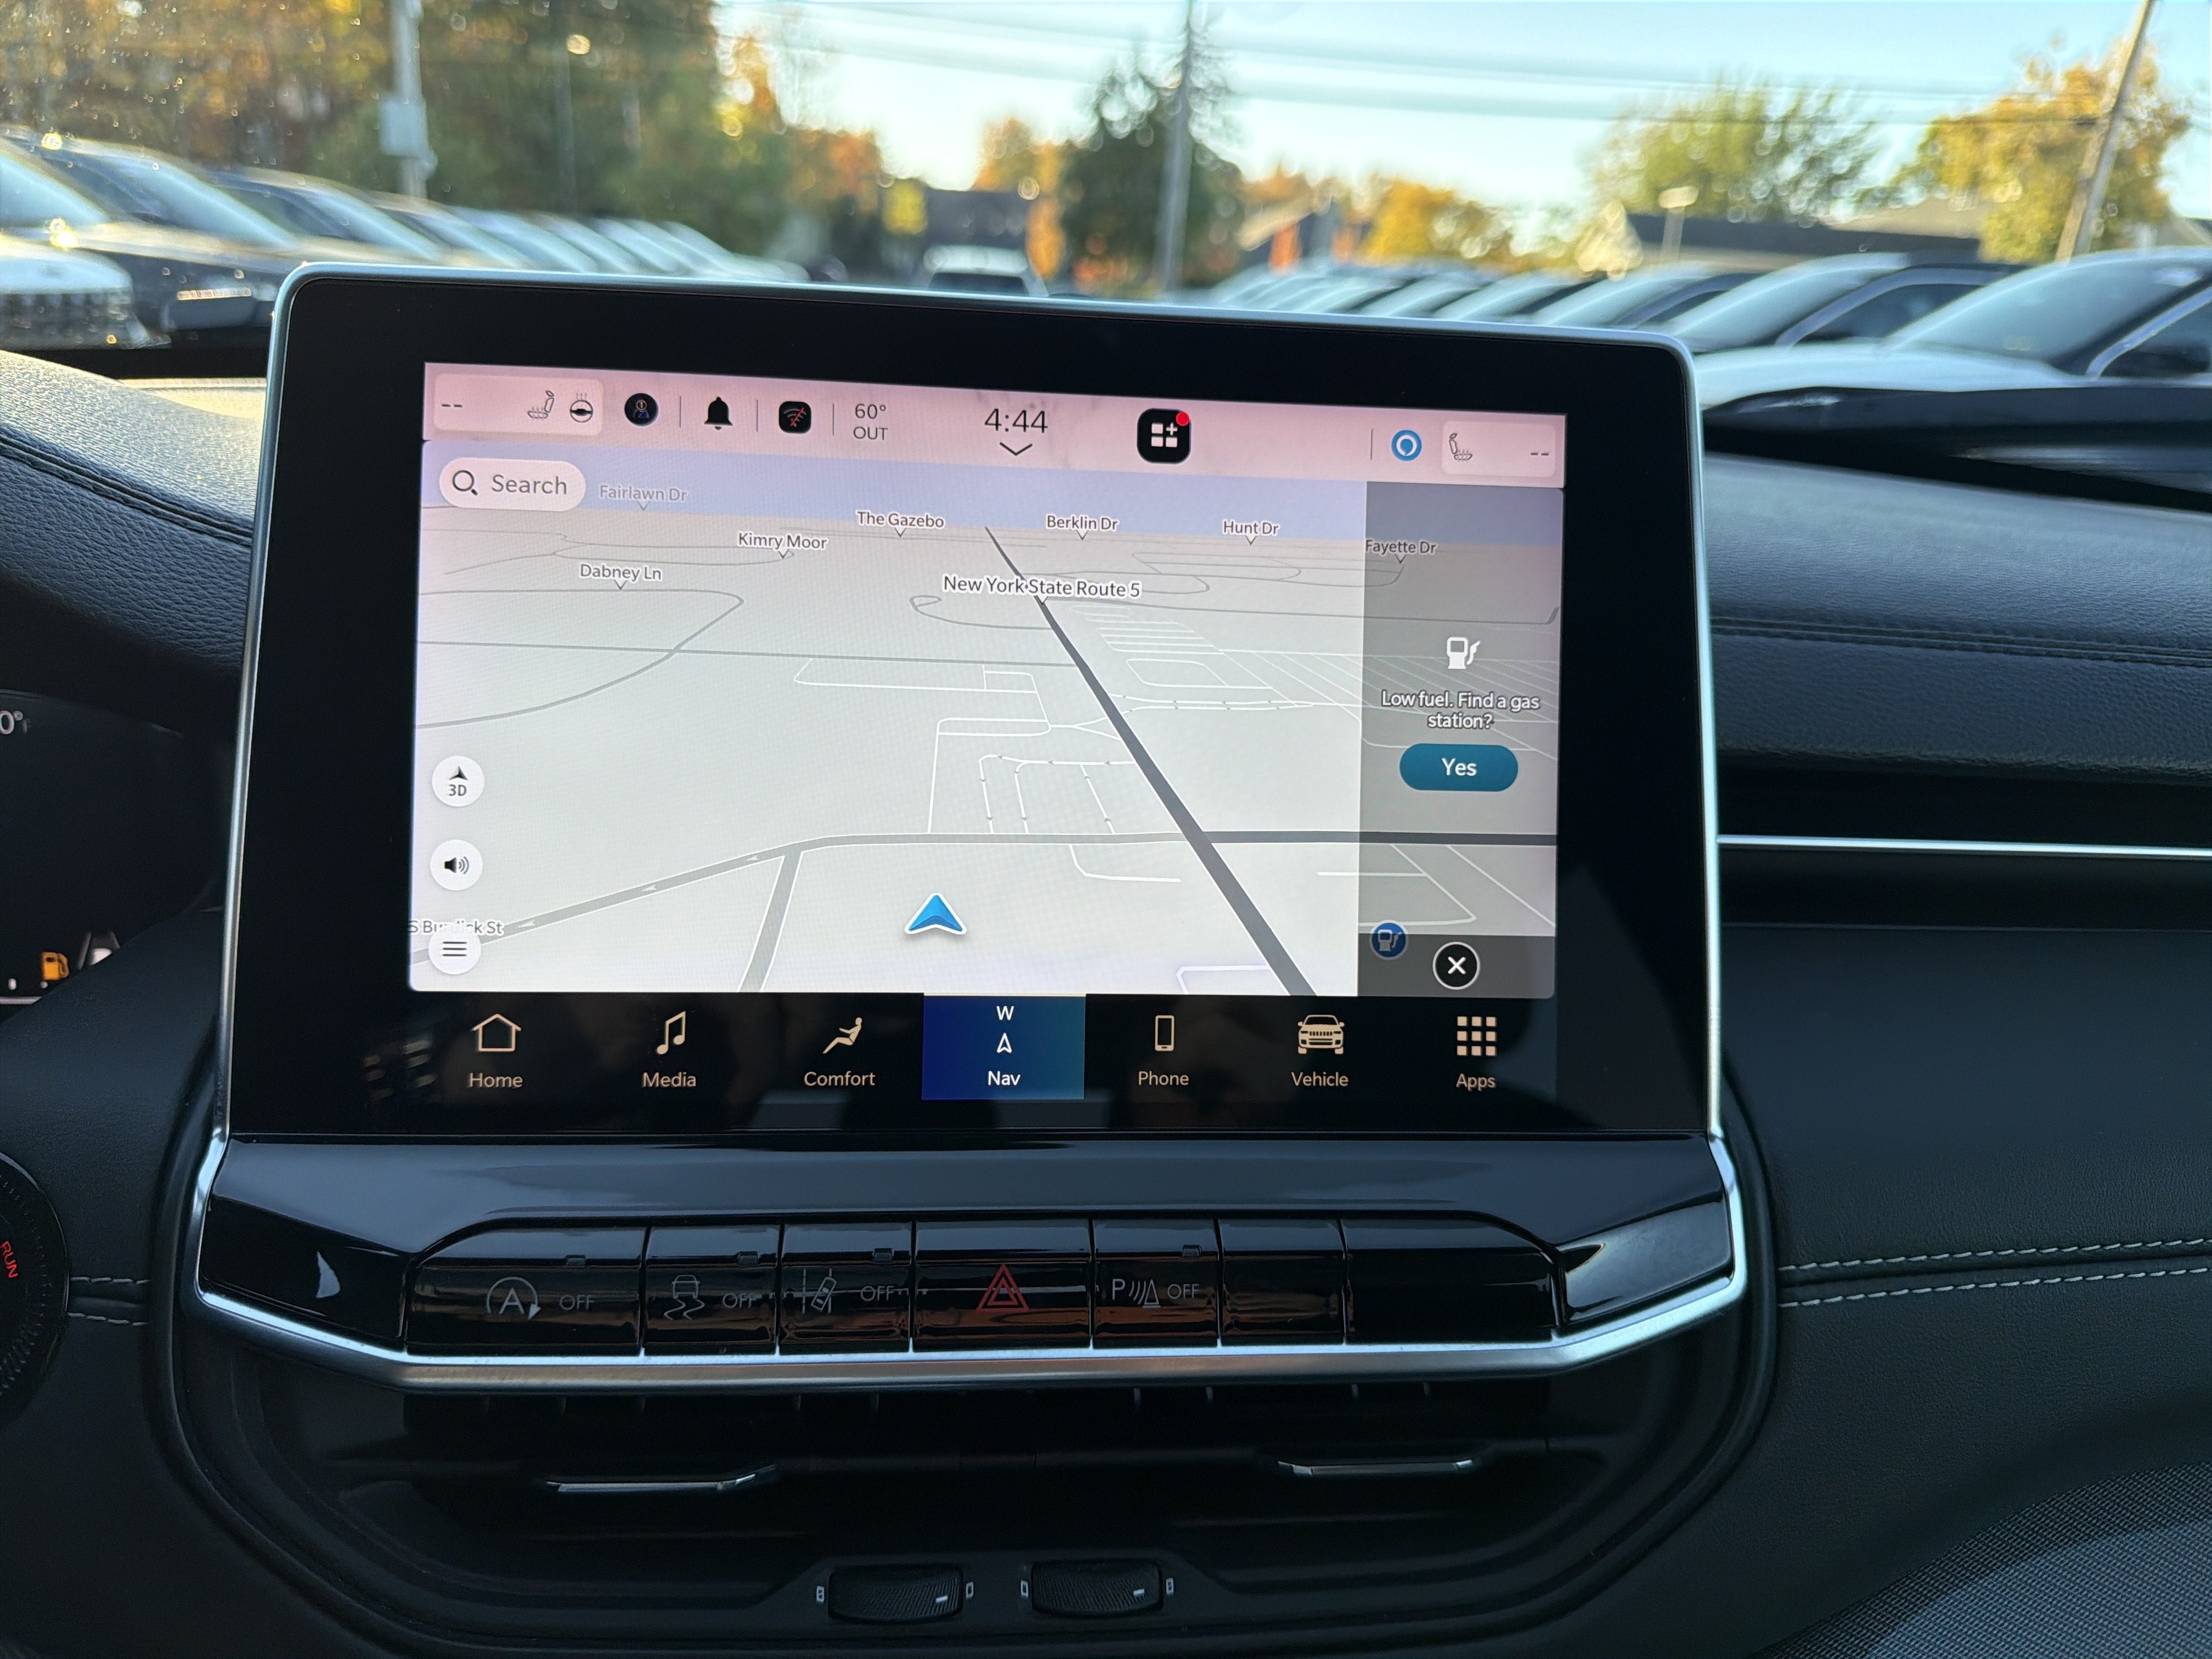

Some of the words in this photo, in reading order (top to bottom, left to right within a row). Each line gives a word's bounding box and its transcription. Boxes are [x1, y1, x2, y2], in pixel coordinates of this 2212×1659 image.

[855, 404, 885, 419] 60°
[985, 409, 1047, 432] 4:44
[854, 427, 887, 440] OUT
[492, 475, 566, 494] Search
[601, 485, 664, 500] Fairlawn
[670, 489, 687, 501] Dr
[857, 512, 884, 524] The
[889, 514, 944, 528] Gazebo
[1048, 516, 1096, 529] Berklin
[1102, 518, 1117, 529] Dr
[1224, 521, 1257, 534] Hunt
[1263, 522, 1278, 534] Dr
[740, 533, 782, 551] Kimry
[787, 535, 826, 549] Moor
[1366, 540, 1415, 556] Fayette
[1420, 541, 1436, 553] Dr
[581, 564, 640, 582] Dabney
[645, 567, 661, 579] Ln
[945, 577, 981, 591] New
[987, 578, 1025, 592] York
[1029, 579, 1071, 594] State
[1077, 582, 1125, 596] Route
[1131, 583, 1139, 597] 5
[1382, 691, 1415, 707] Low
[1419, 692, 1453, 708] fuel.
[1458, 693, 1493, 708] Find
[1497, 697, 1506, 709] a
[1511, 697, 1539, 712] gas
[1427, 714, 1492, 729] station?
[1442, 758, 1476, 776] Yes
[449, 785, 466, 796] 3D
[487, 922, 503, 934] St
[997, 1006, 1014, 1020] W
[470, 1073, 522, 1087] Home
[644, 1072, 696, 1087] Media
[804, 1071, 875, 1086] Comfort
[989, 1071, 1020, 1085] Nav
[1139, 1071, 1188, 1085] Phone
[1291, 1072, 1348, 1086] Vehicle
[1457, 1074, 1495, 1091] Apps
[0, 1240, 19, 1278] RUN
[860, 1286, 894, 1301] OFF
[1112, 1278, 1125, 1299] P
[1167, 1284, 1199, 1299] OFF
[498, 1288, 525, 1314] A
[559, 1295, 594, 1311] OFF
[723, 1294, 757, 1308] OFF
